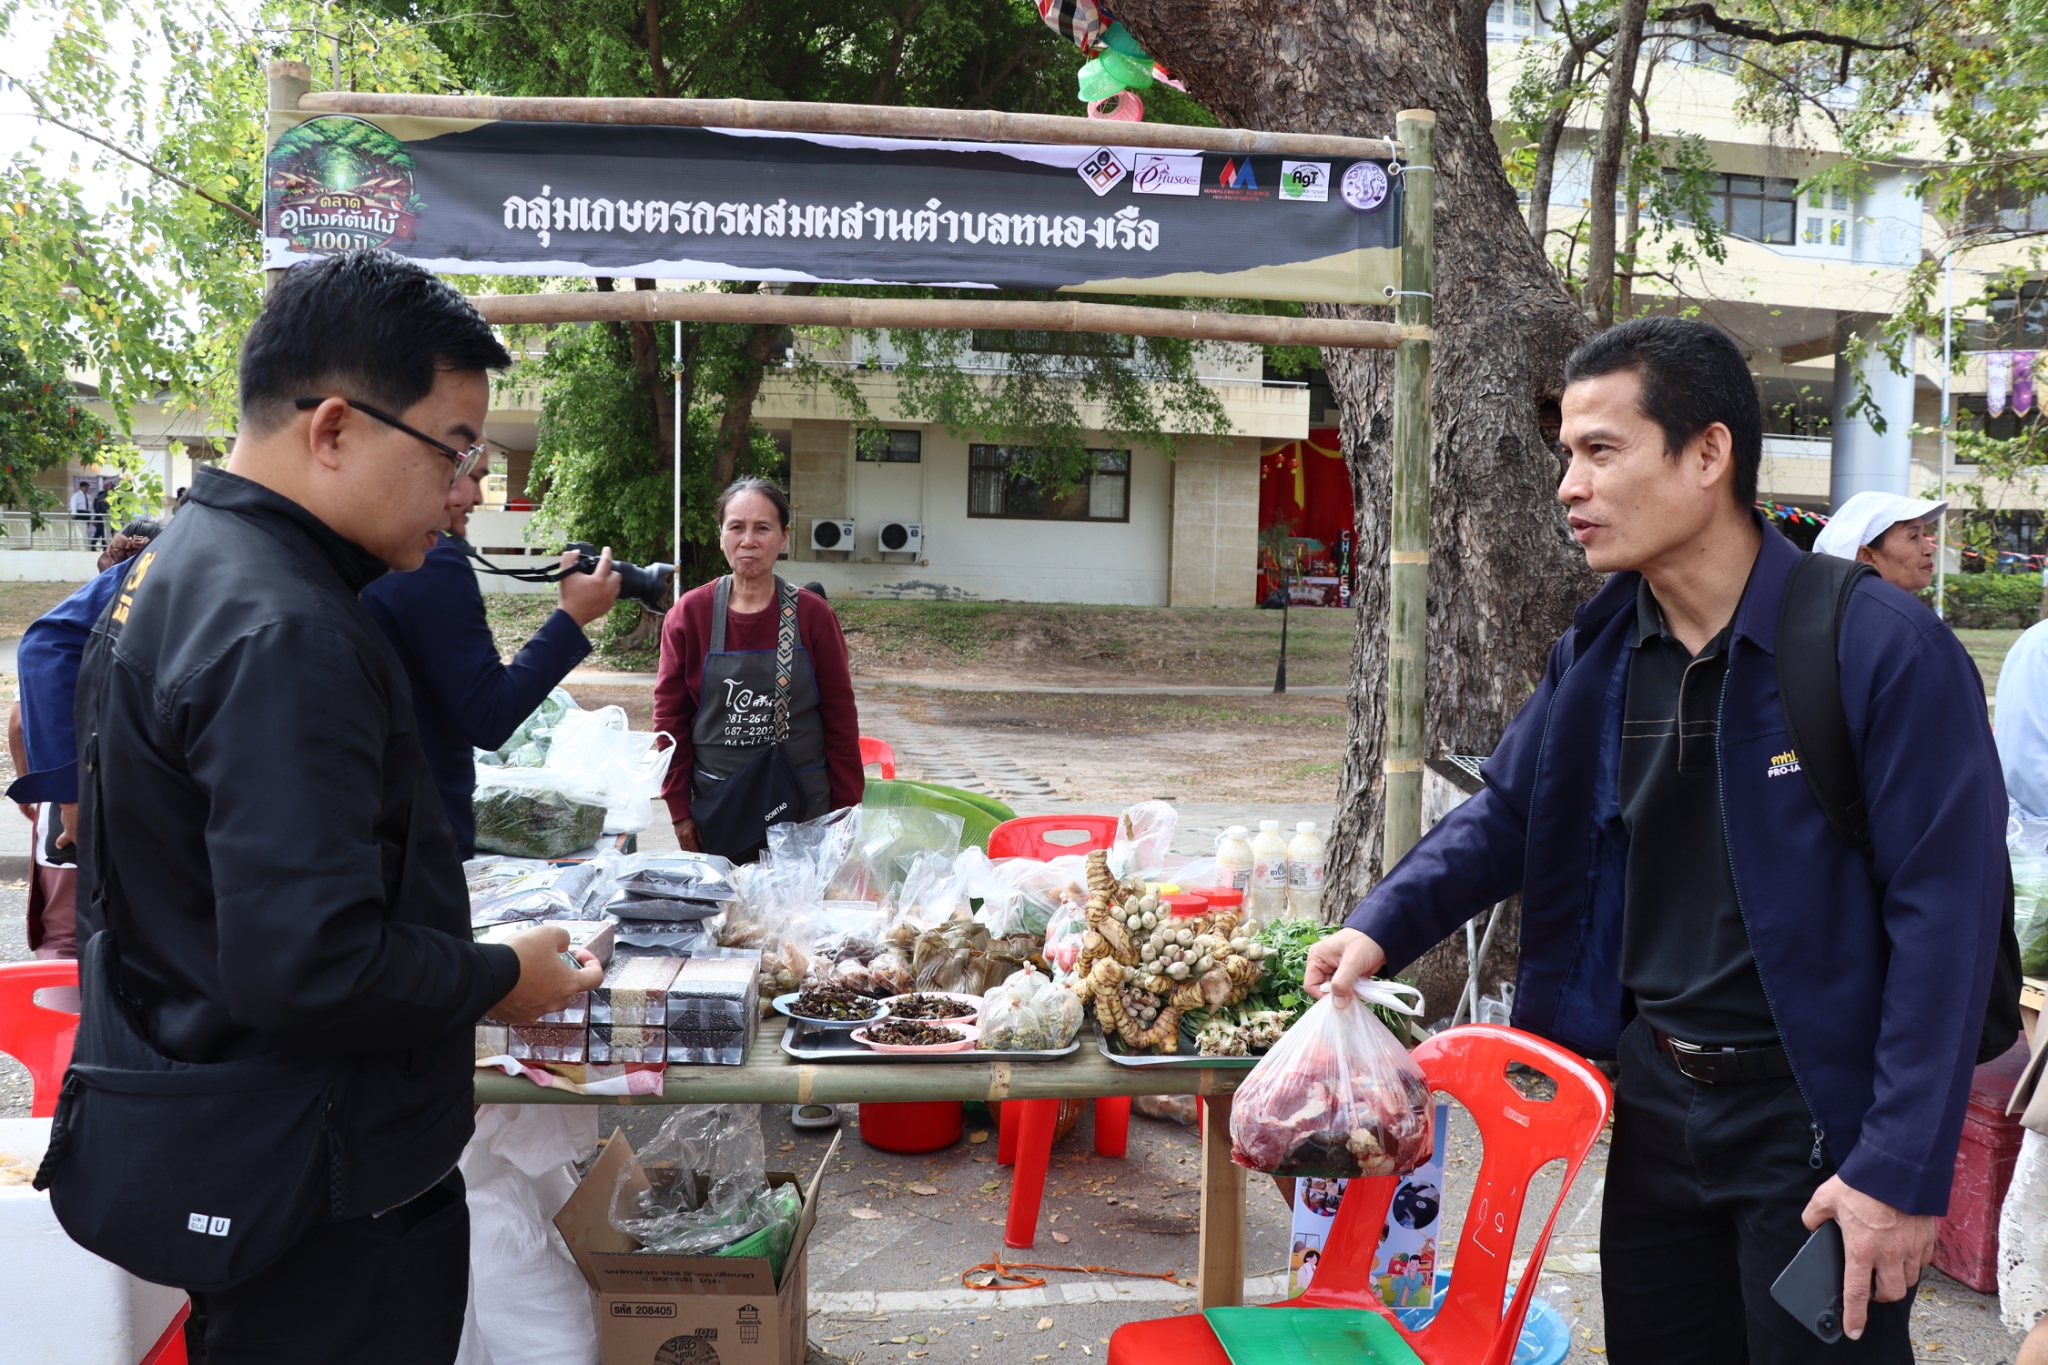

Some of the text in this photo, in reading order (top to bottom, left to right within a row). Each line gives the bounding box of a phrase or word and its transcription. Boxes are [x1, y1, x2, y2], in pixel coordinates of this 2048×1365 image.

[320, 195, 361, 209] ตลาด
[280, 206, 400, 234] อุโมงค์ต้นไม้
[503, 184, 1160, 251] กลุ่มเกษตรกรผสมผสานตำบลหนองเรือ
[312, 232, 368, 250] 100 ปี
[1339, 530, 1351, 608] CHINESE
[192, 1215, 206, 1223] UNI
[214, 1220, 226, 1233] U
[614, 1303, 673, 1316] รหัส 208405
